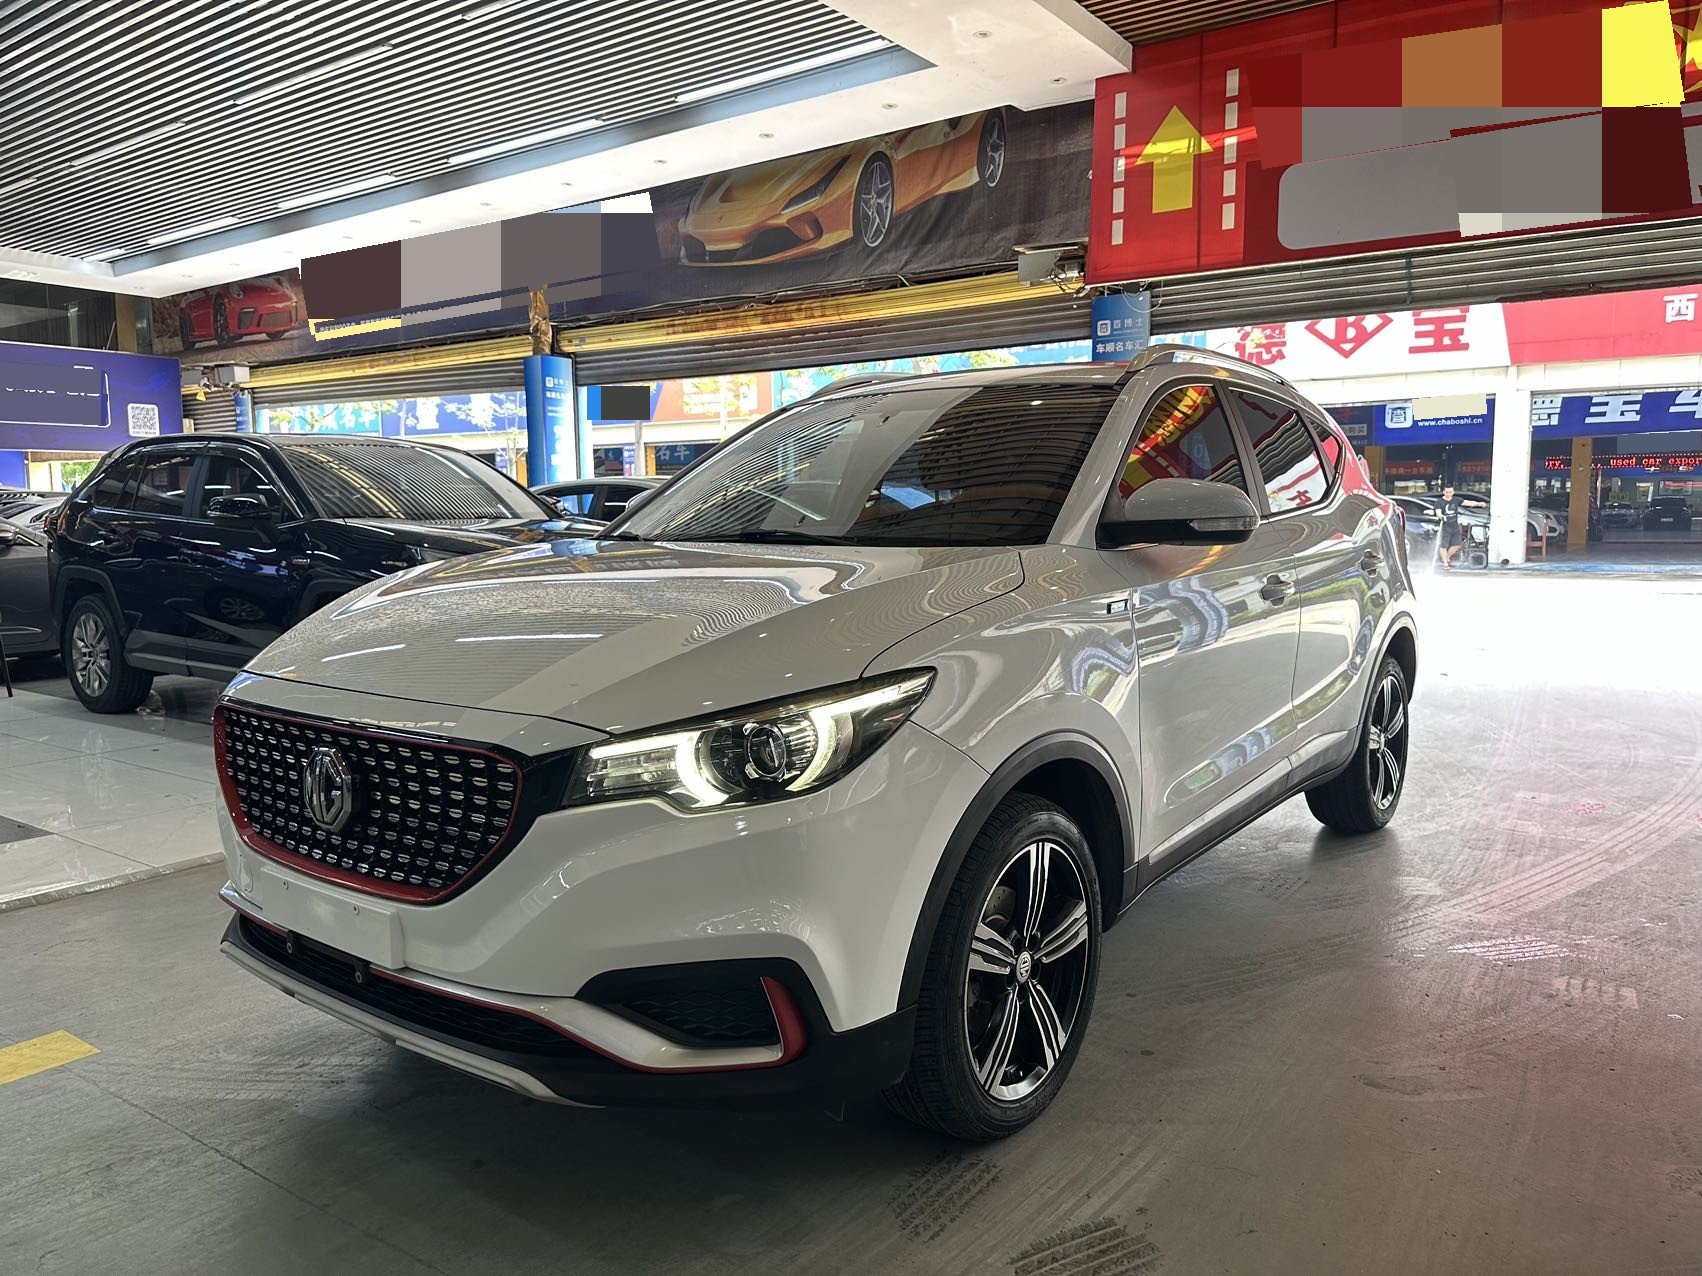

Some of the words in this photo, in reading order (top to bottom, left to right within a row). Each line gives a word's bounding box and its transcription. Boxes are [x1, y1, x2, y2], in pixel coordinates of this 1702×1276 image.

[1663, 293, 1698, 323] 西
[1417, 417, 1483, 427] www.chaboshi.cn
[1610, 458, 1636, 467] used
[1642, 457, 1662, 466] car
